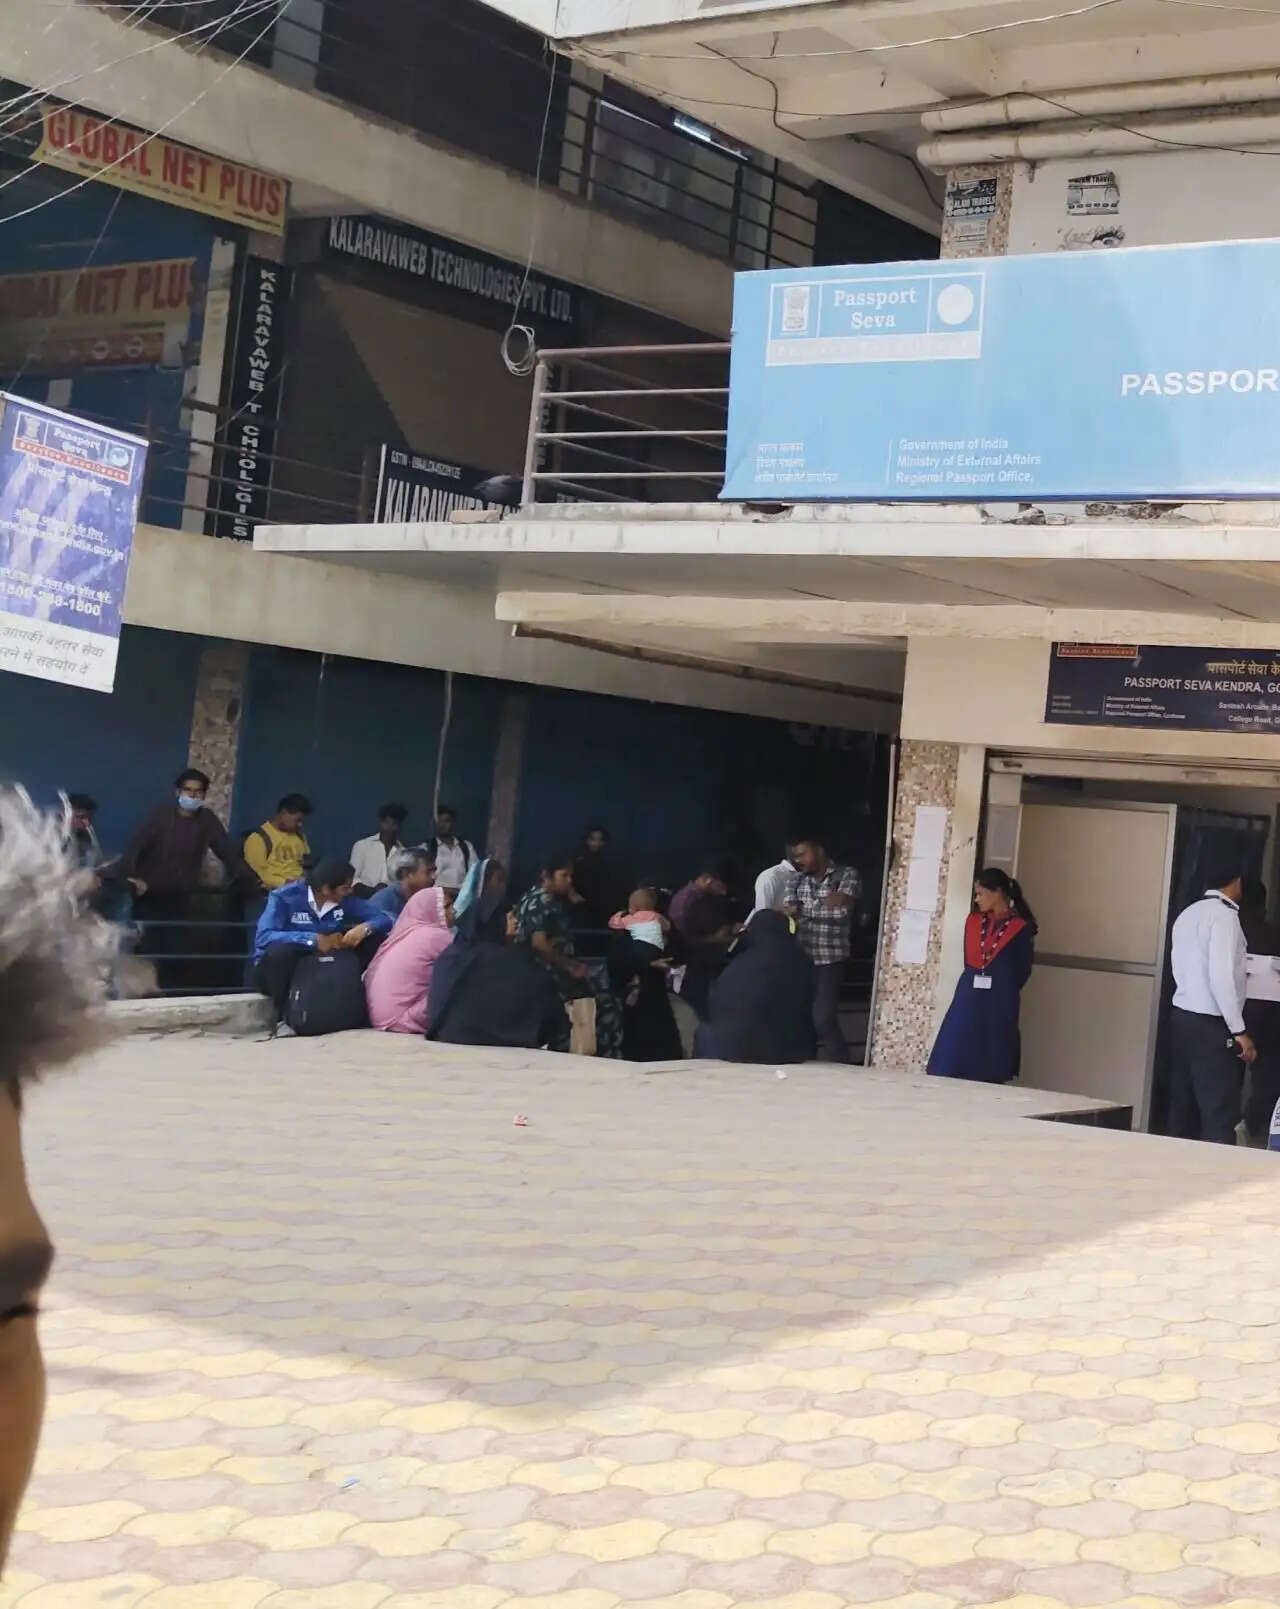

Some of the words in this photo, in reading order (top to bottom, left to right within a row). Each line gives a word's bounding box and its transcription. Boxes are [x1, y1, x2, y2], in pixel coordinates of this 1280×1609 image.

[48, 107, 152, 177] GLOBAL
[161, 143, 212, 194] NET
[219, 164, 282, 217] PLUS
[329, 215, 428, 276] KALARAVAWEB
[431, 247, 521, 305] TECHNOLOGIES
[833, 287, 918, 311] Passport
[850, 311, 896, 329] Seva
[249, 268, 277, 392] KALARAVAWEB
[899, 439, 965, 451] Government
[968, 438, 978, 450] of
[980, 438, 1009, 449] India
[896, 455, 941, 469] Ministry
[942, 455, 954, 466] of
[1004, 453, 1042, 465] Affairs
[946, 471, 995, 485] Passport
[1124, 676, 1182, 690] PASSPORT
[1184, 679, 1214, 692] SEVA
[1215, 681, 1264, 694] KENDRA,
